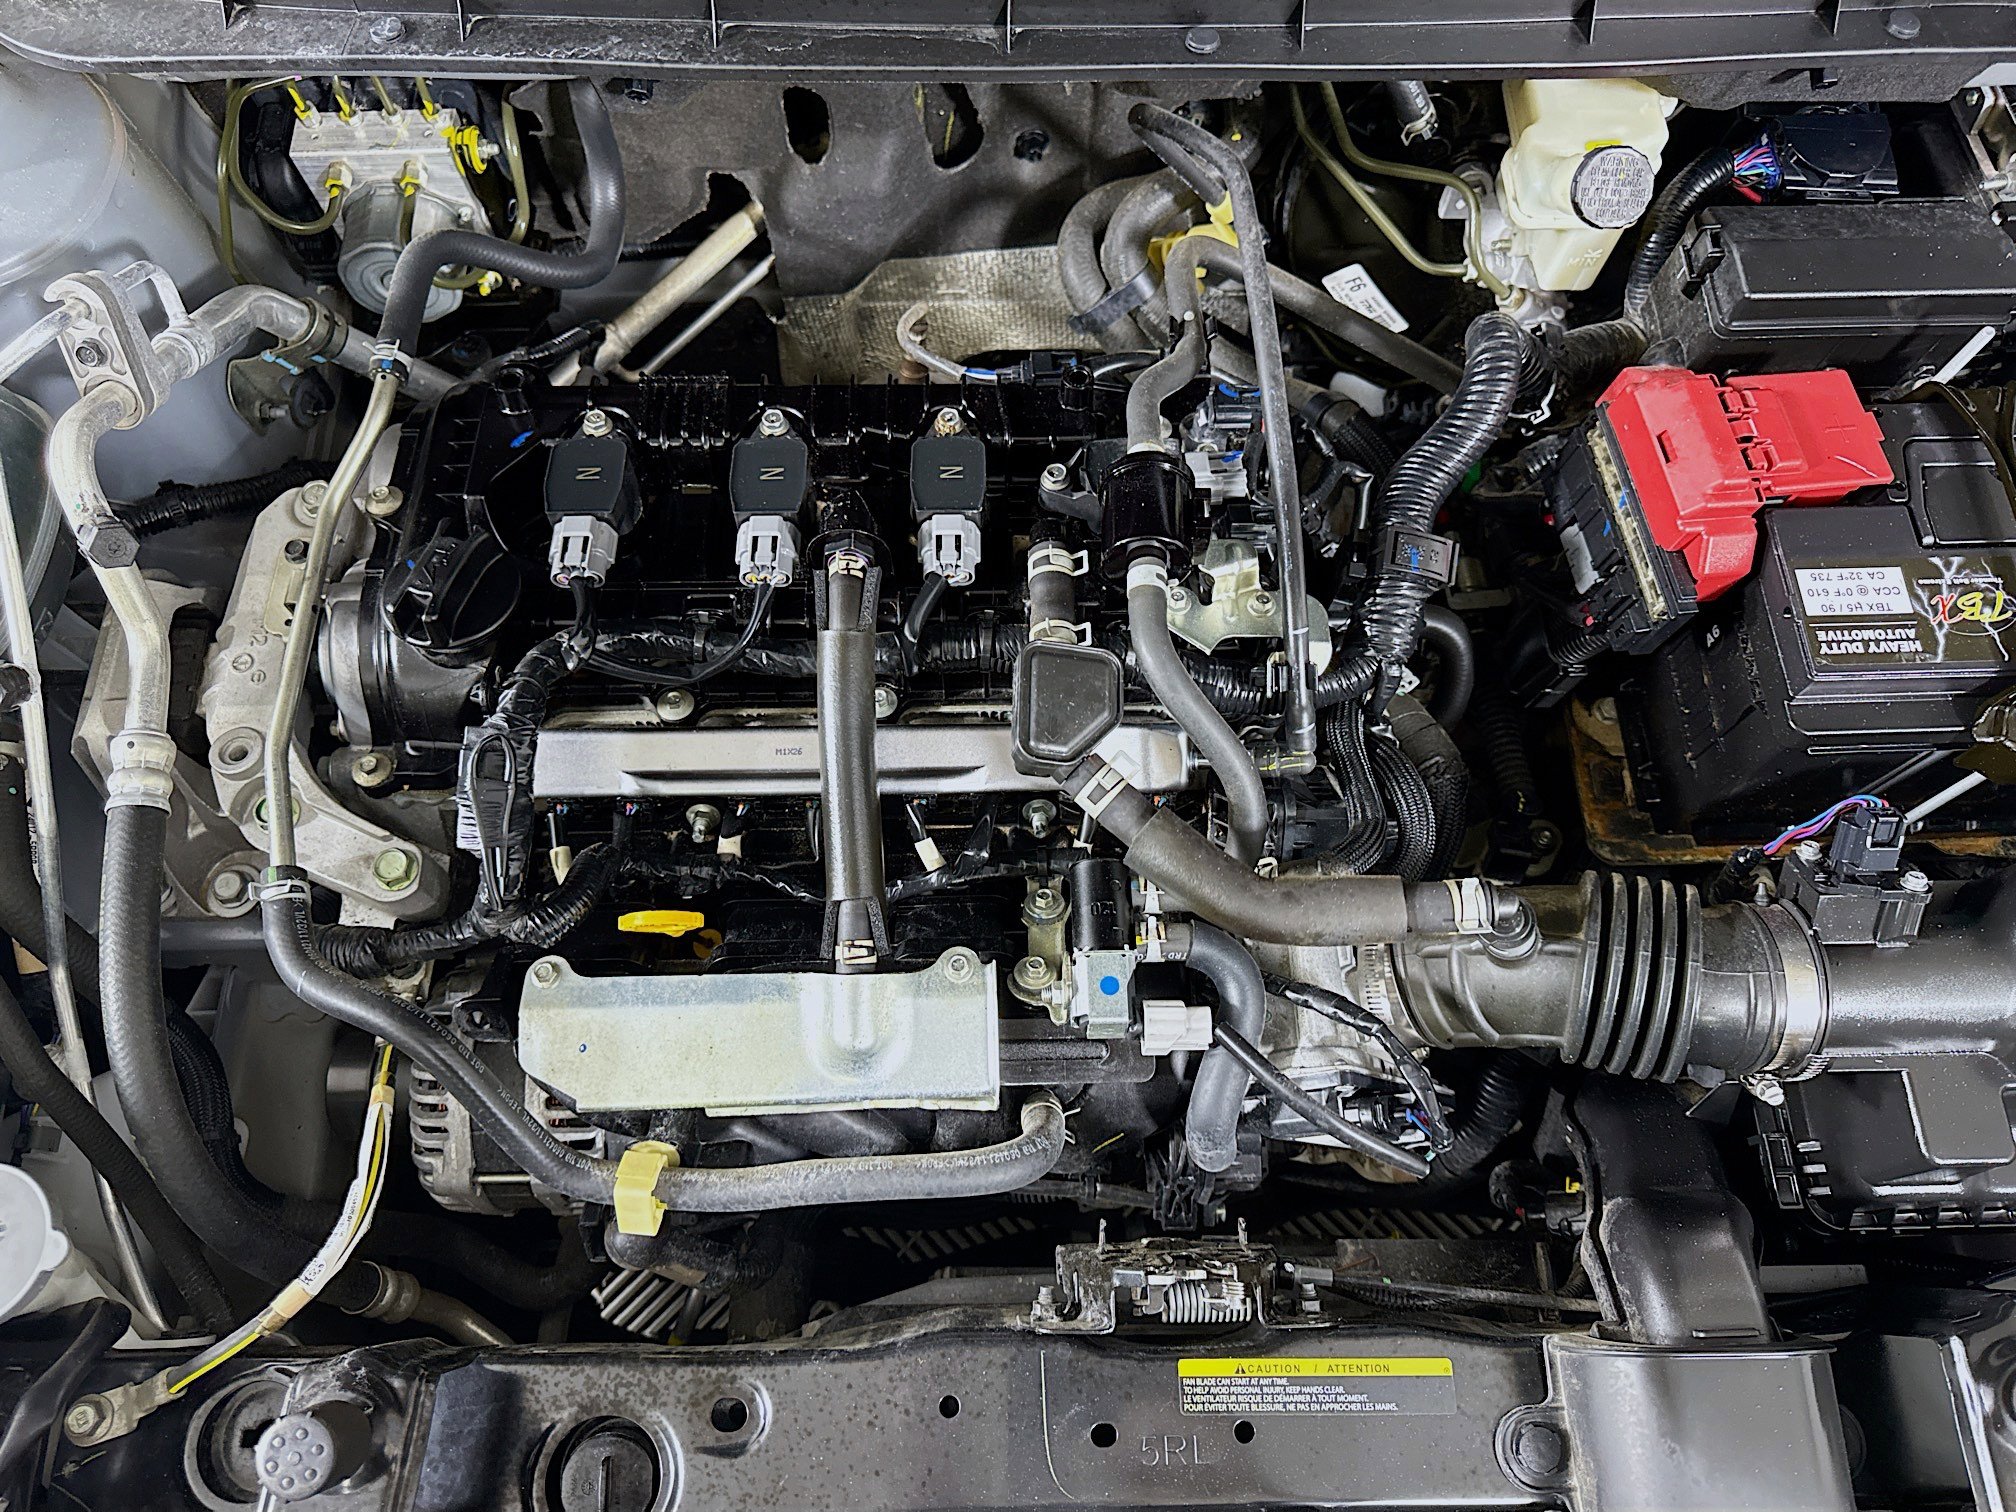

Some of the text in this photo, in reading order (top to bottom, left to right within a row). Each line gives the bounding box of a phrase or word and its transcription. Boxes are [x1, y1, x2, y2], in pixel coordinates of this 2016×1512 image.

[1810, 572, 1833, 581] 735
[1866, 571, 1885, 580] CA
[1807, 588, 1829, 597] 610
[1856, 585, 1869, 597] @
[1872, 586, 1901, 596] CCA
[1821, 604, 1836, 613] 90
[1865, 602, 1894, 612] TBX
[1930, 590, 2013, 625] TBX
[1815, 628, 1917, 641] AUTOMOTIVE
[1820, 640, 1923, 655] HEAVY DUTY
[1168, 952, 1188, 960] TRD
[426, 1017, 457, 1045] 060421
[1247, 1364, 1301, 1374] CAUTION
[1327, 1364, 1391, 1373] ATTENTION
[1182, 1377, 1290, 1386] FAN BLADE CAN START AT ANY TIME.
[1183, 1386, 1193, 1395] TO
[1193, 1386, 1210, 1395] HELP
[1210, 1386, 1230, 1394] AVOID
[1230, 1386, 1262, 1394] PERSONAL
[1285, 1386, 1301, 1394] KEEP
[1301, 1386, 1324, 1394] HANDS
[1323, 1386, 1346, 1394] CLEAR.
[1183, 1395, 1193, 1403] LE
[1192, 1395, 1238, 1403] VENTILATEUR
[1238, 1395, 1263, 1403] RISQUE
[1263, 1395, 1274, 1403] DE
[1274, 1393, 1312, 1403] DÉMARRER
[1337, 1394, 1369, 1402] MOMENT.
[1184, 1402, 1399, 1412] POUR ÉVITER TOUTE BLESSURE, NE PAS EN APPROCHER LES MAINS.
[1141, 1434, 1211, 1466] 5RL
